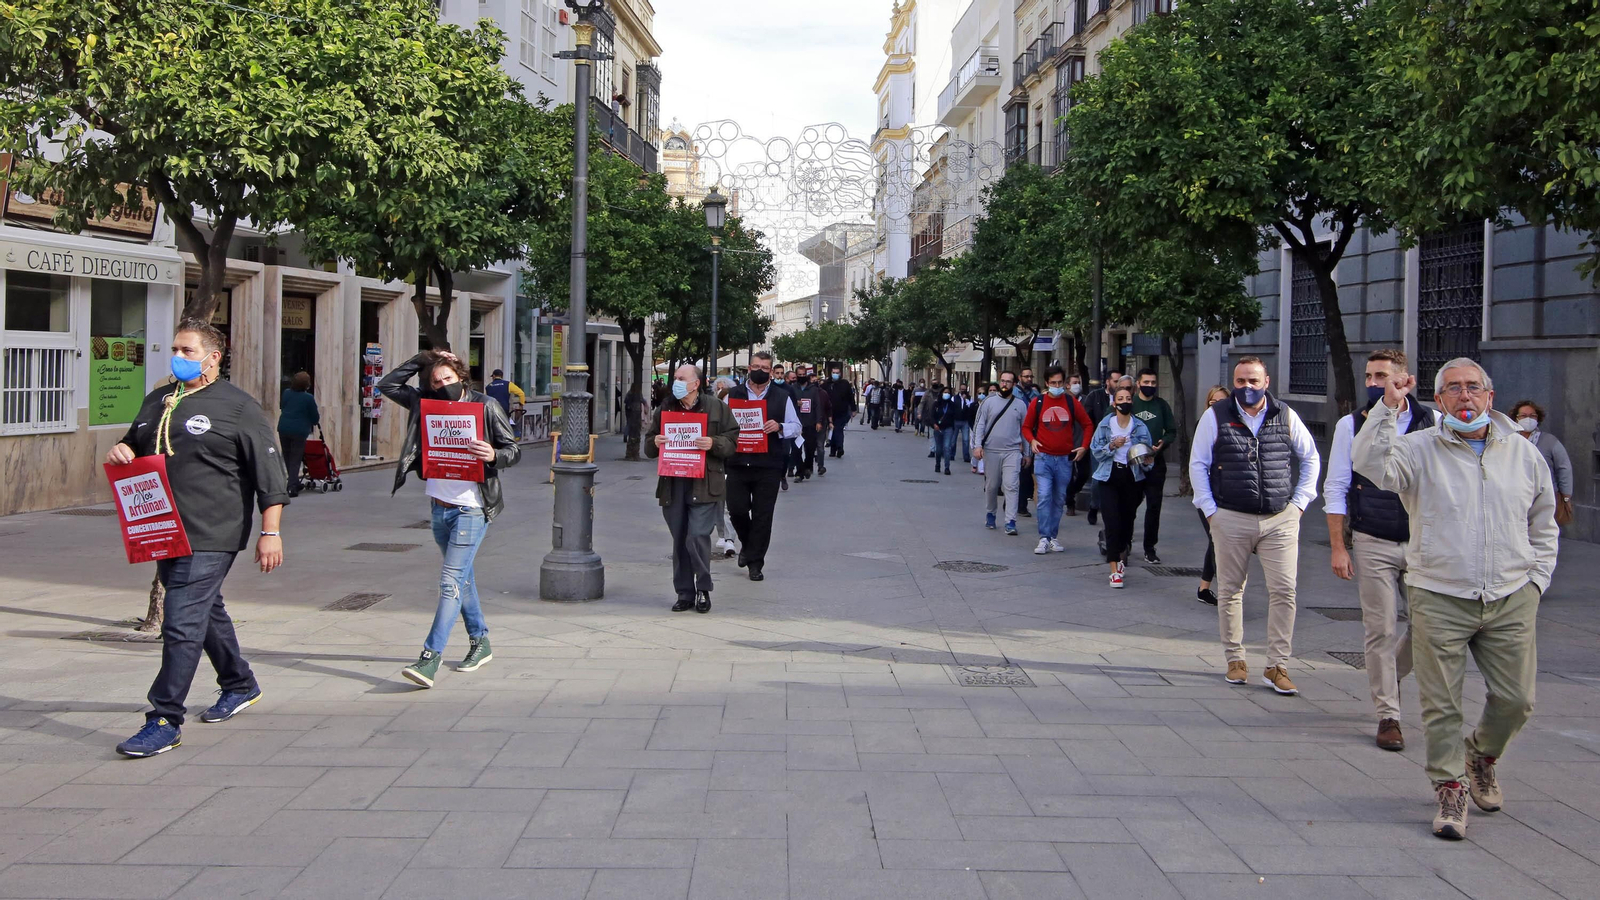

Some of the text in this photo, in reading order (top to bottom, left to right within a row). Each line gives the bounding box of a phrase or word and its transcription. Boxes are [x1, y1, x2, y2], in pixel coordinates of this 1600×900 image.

[27, 250, 158, 281] CAFÉ DIEGUITO
[282, 316, 303, 326] GALOS
[431, 420, 472, 429] SIN AYUDAS
[439, 427, 462, 438] Nos
[121, 479, 159, 496] SIN AYUDAS
[133, 490, 154, 506] Nos
[129, 497, 168, 518] Arruinan!
[127, 519, 177, 535] CONCENTRACIONES
[423, 650, 432, 659] 23
